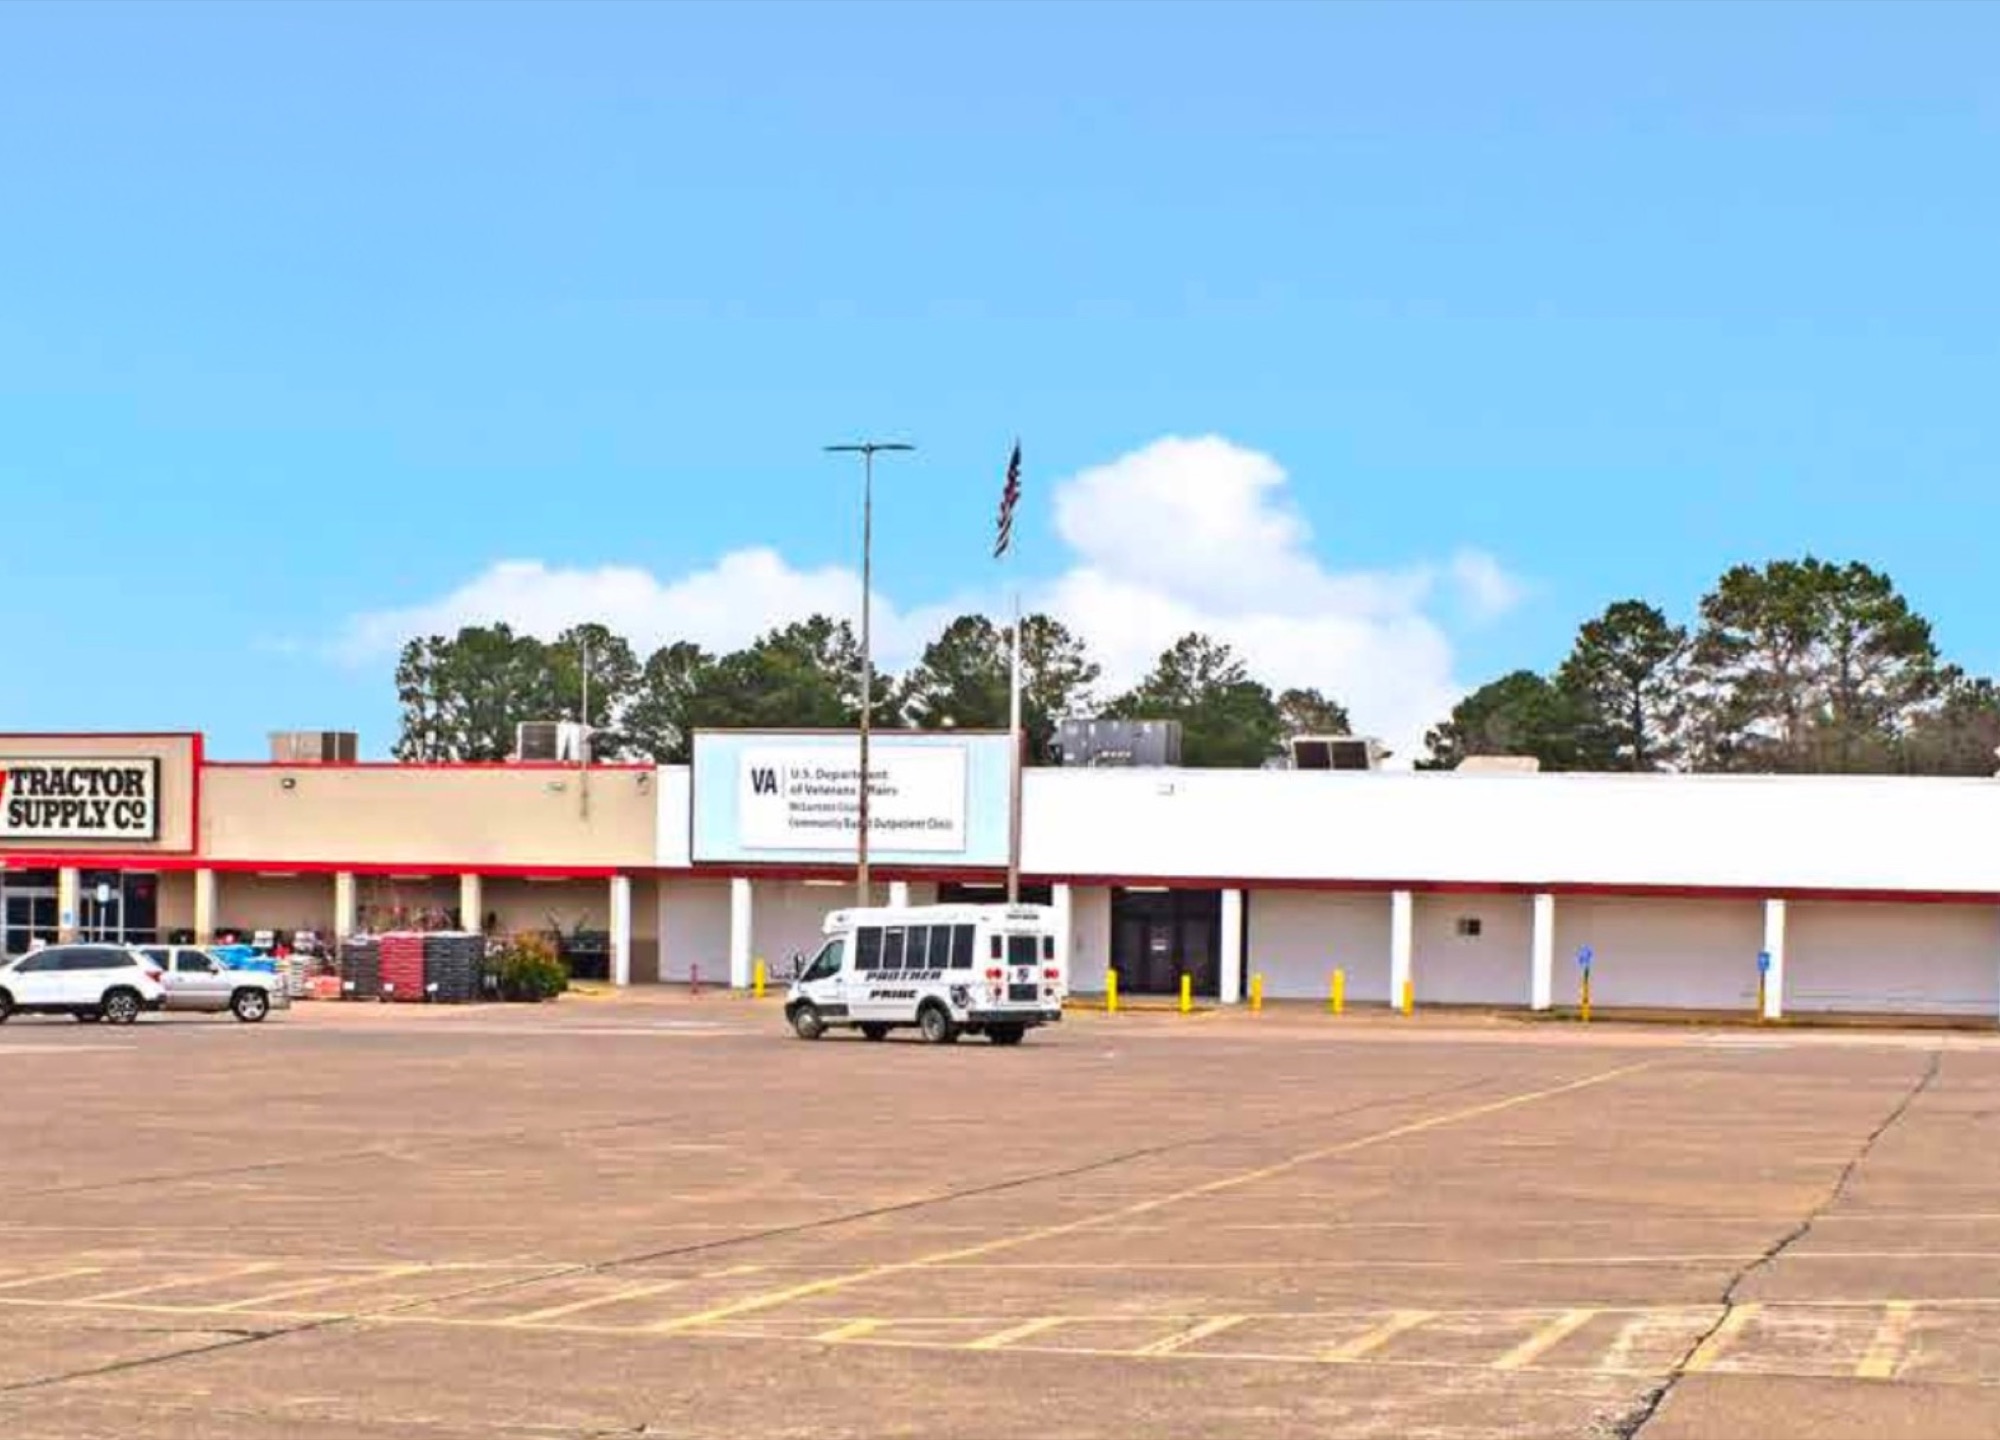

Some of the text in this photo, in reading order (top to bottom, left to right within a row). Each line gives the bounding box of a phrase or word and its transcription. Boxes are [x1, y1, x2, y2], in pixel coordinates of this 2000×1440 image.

[8, 767, 144, 796] TRACTOR
[751, 767, 778, 794] VA
[790, 767, 888, 781] U.S. Departent
[790, 783, 802, 795] of
[861, 783, 898, 796] ffairs
[8, 799, 110, 829] SUPPLY
